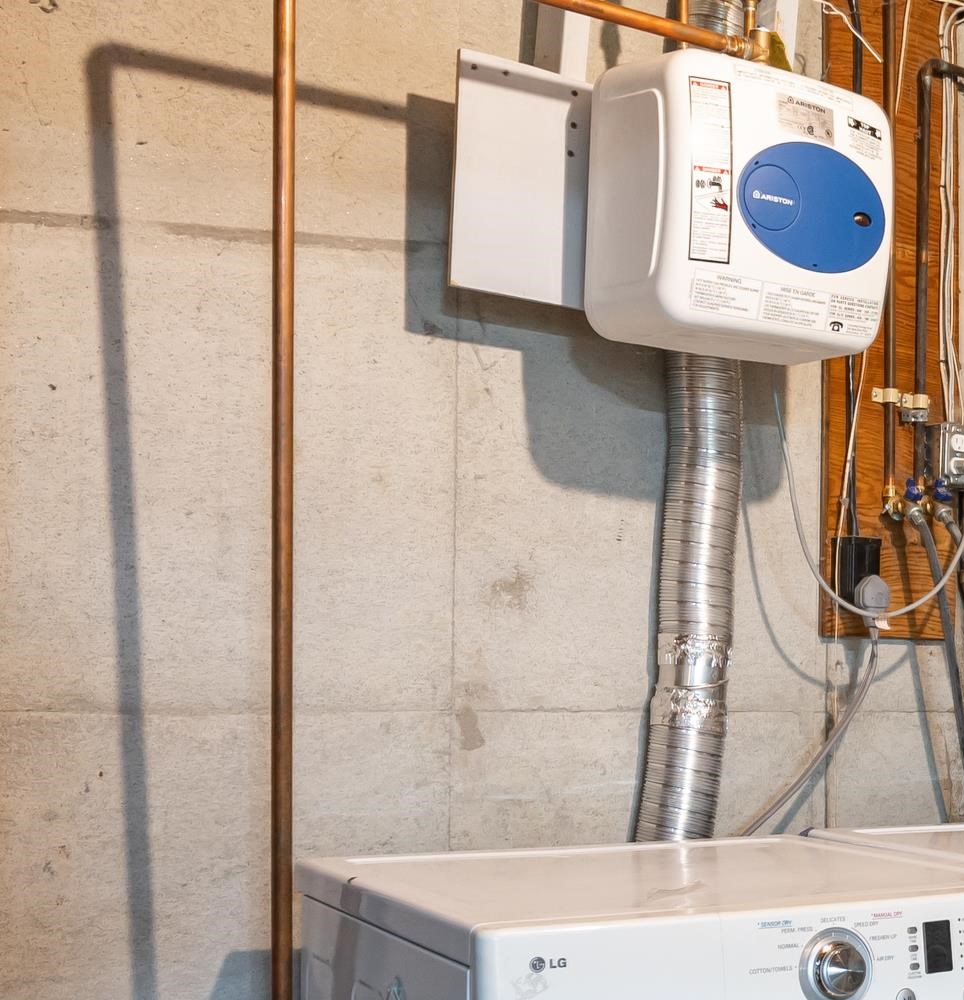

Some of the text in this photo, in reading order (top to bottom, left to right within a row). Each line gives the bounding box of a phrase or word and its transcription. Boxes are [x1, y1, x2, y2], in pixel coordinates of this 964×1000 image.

[795, 100, 826, 114] ARISTON
[761, 194, 793, 206] ARISTON
[549, 957, 567, 969] LG
[749, 965, 793, 975] COTTON/TOWELS
